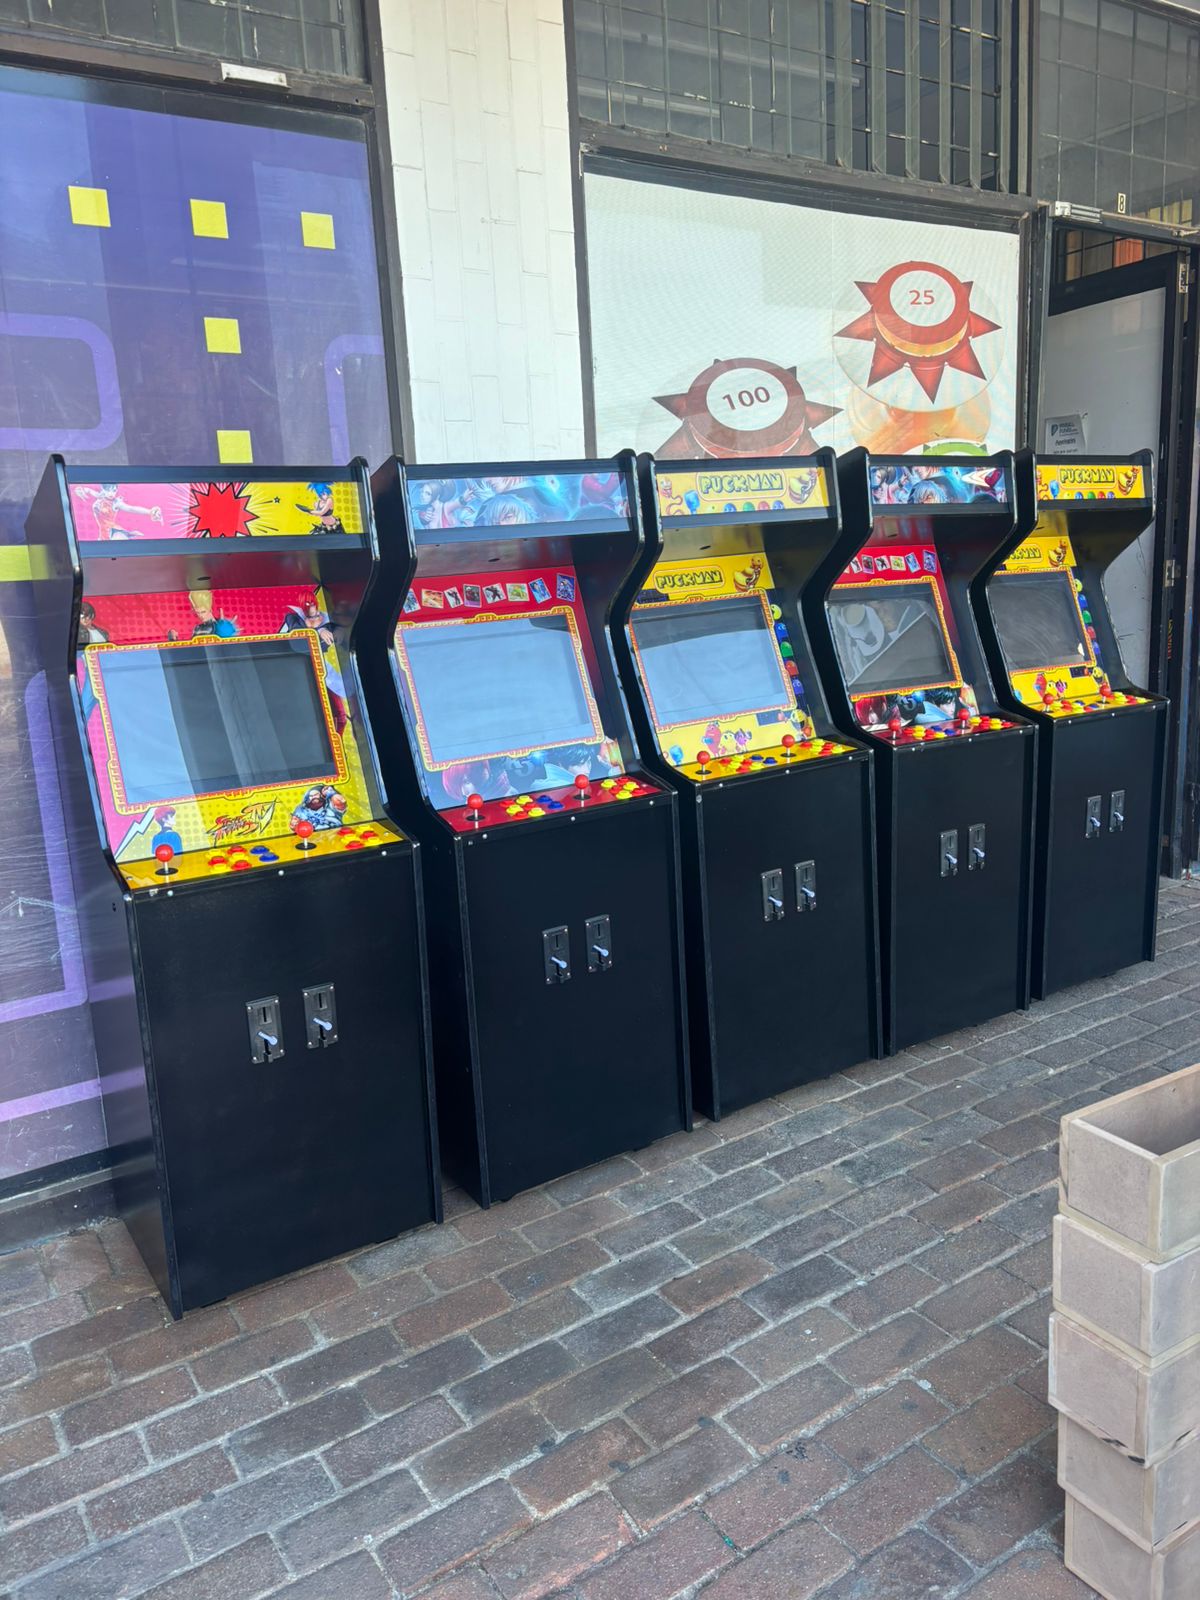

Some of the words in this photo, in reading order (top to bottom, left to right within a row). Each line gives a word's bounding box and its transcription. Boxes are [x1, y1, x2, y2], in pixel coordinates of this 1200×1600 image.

[909, 289, 935, 305] 25
[722, 386, 770, 411] 100
[700, 472, 784, 495] PUCKMAN
[1060, 468, 1115, 484] PUCKMAN
[655, 569, 724, 590] PUCKMAN
